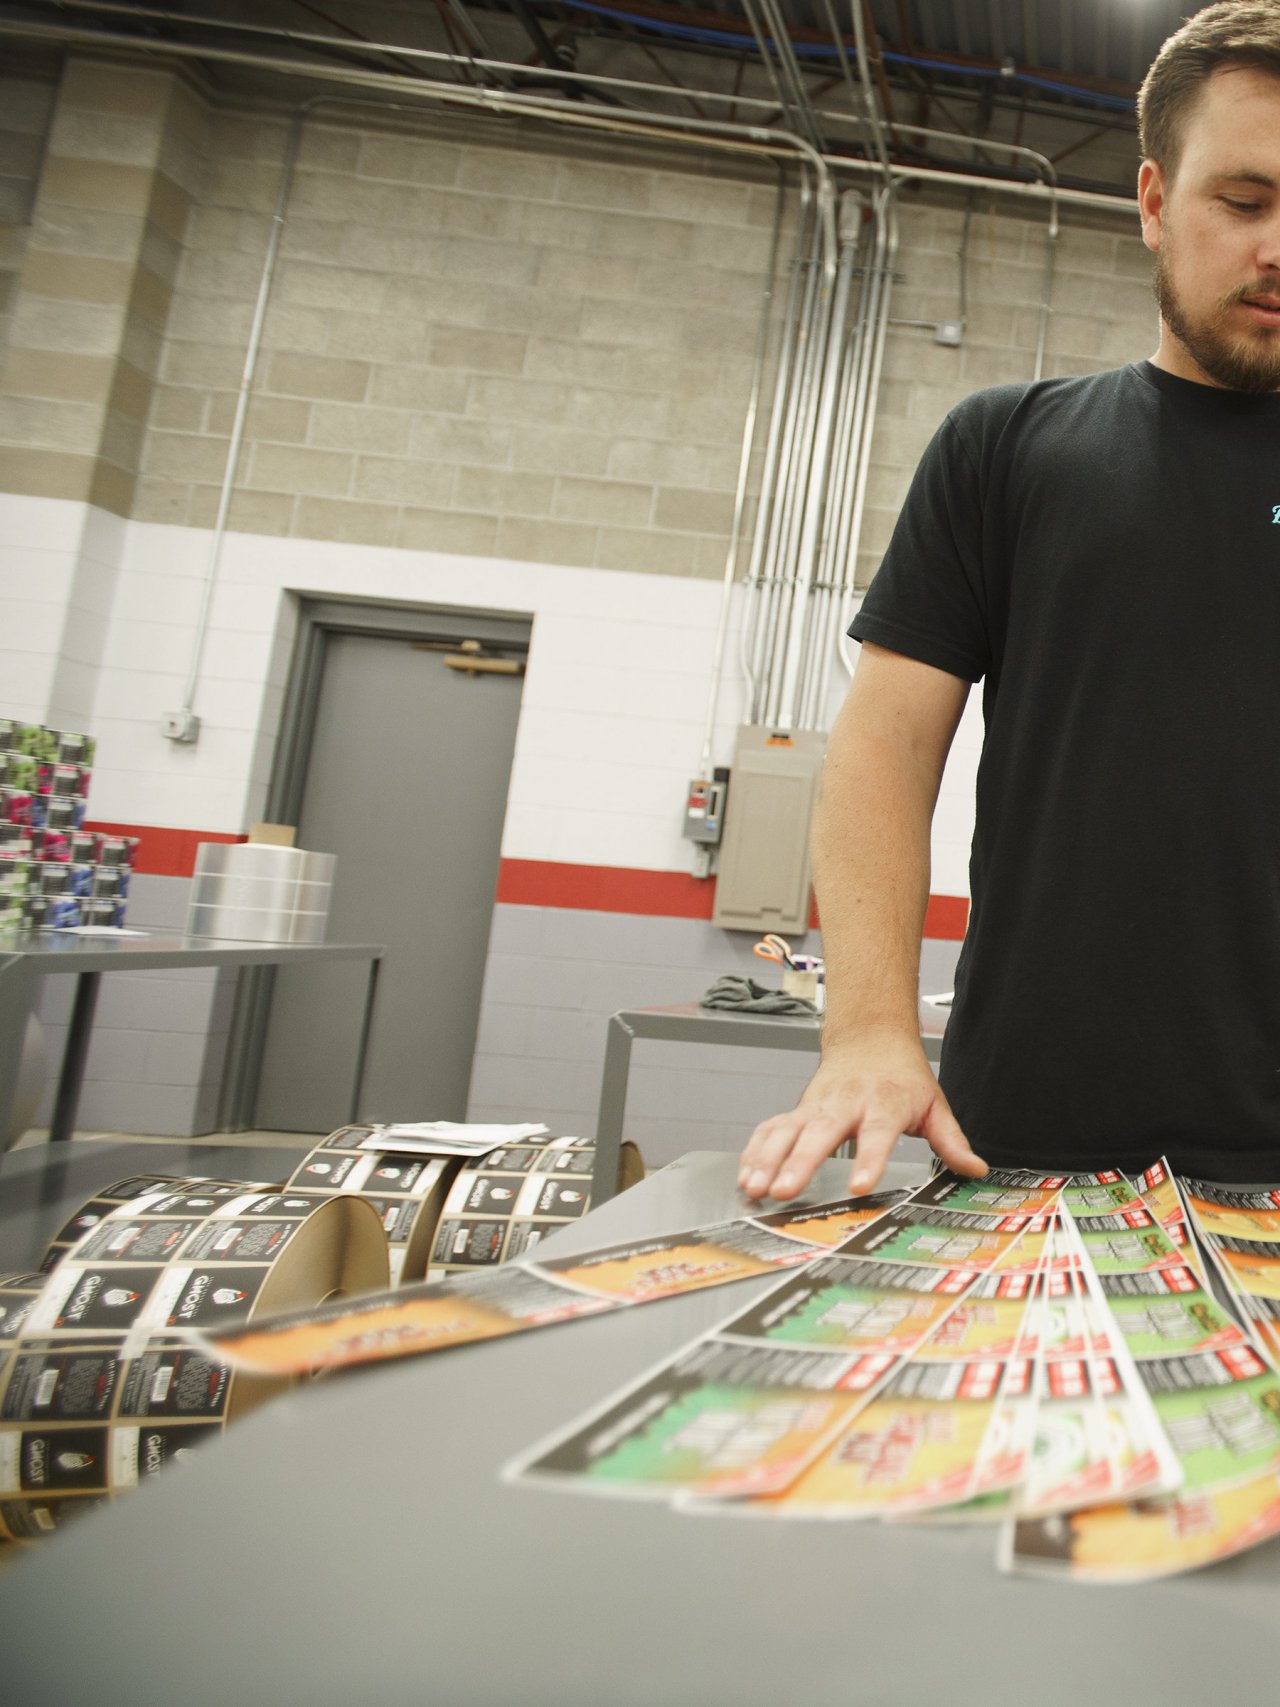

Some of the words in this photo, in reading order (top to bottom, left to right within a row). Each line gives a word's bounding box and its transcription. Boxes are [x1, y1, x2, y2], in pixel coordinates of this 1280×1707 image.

[67, 1275, 102, 1322] GHOST
[178, 1274, 210, 1320] GHOST
[30, 1439, 46, 1484] GHOST
